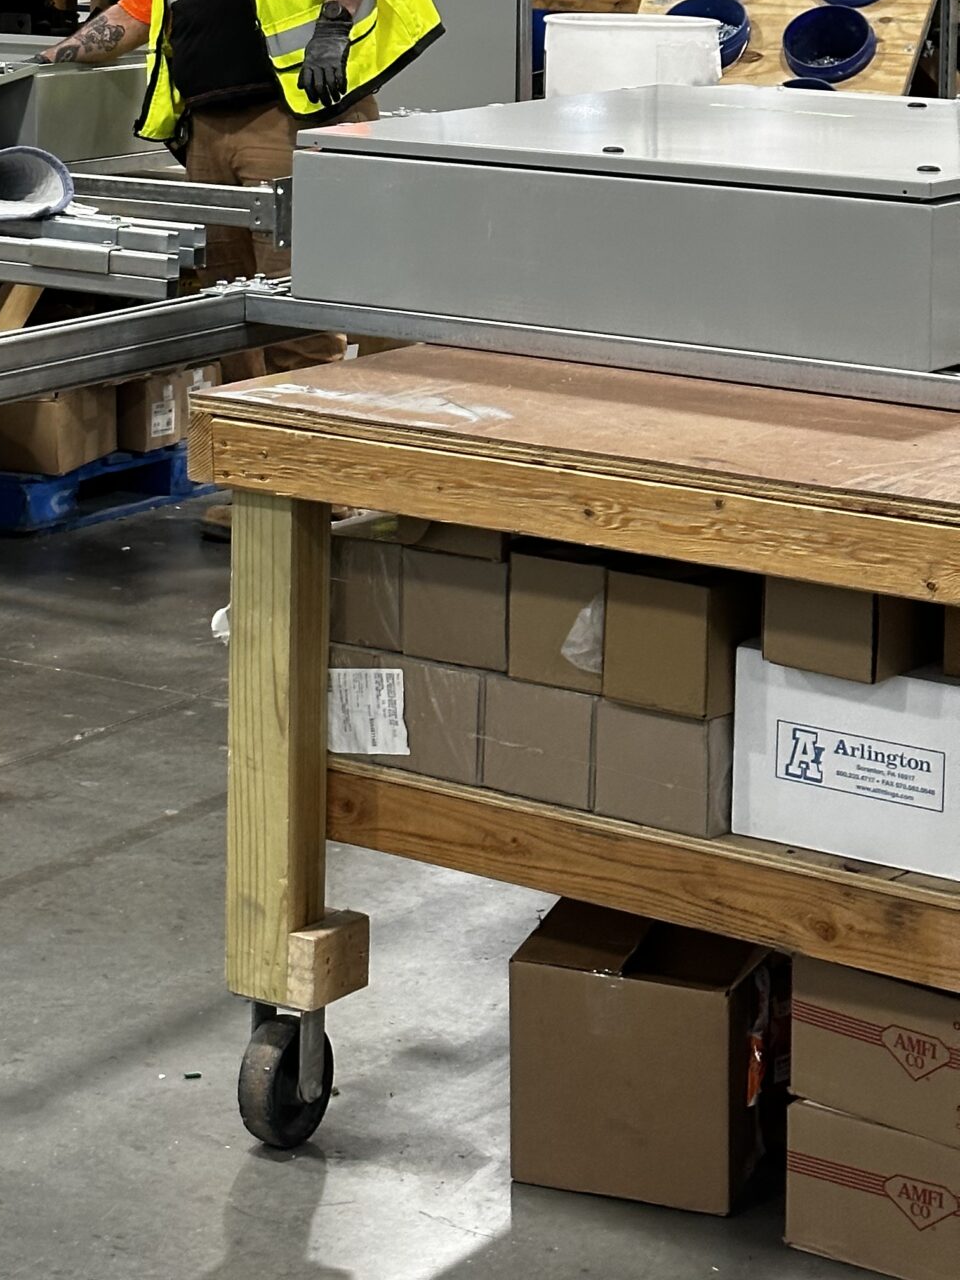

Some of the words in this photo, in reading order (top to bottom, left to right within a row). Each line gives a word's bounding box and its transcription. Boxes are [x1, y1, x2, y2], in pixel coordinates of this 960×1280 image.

[833, 738, 932, 773] Arlington
[881, 779, 895, 787] FAX
[893, 1032, 938, 1060] AMFI
[905, 1052, 925, 1070] CO
[898, 1182, 945, 1209] AMFI
[909, 1201, 931, 1219] CO
